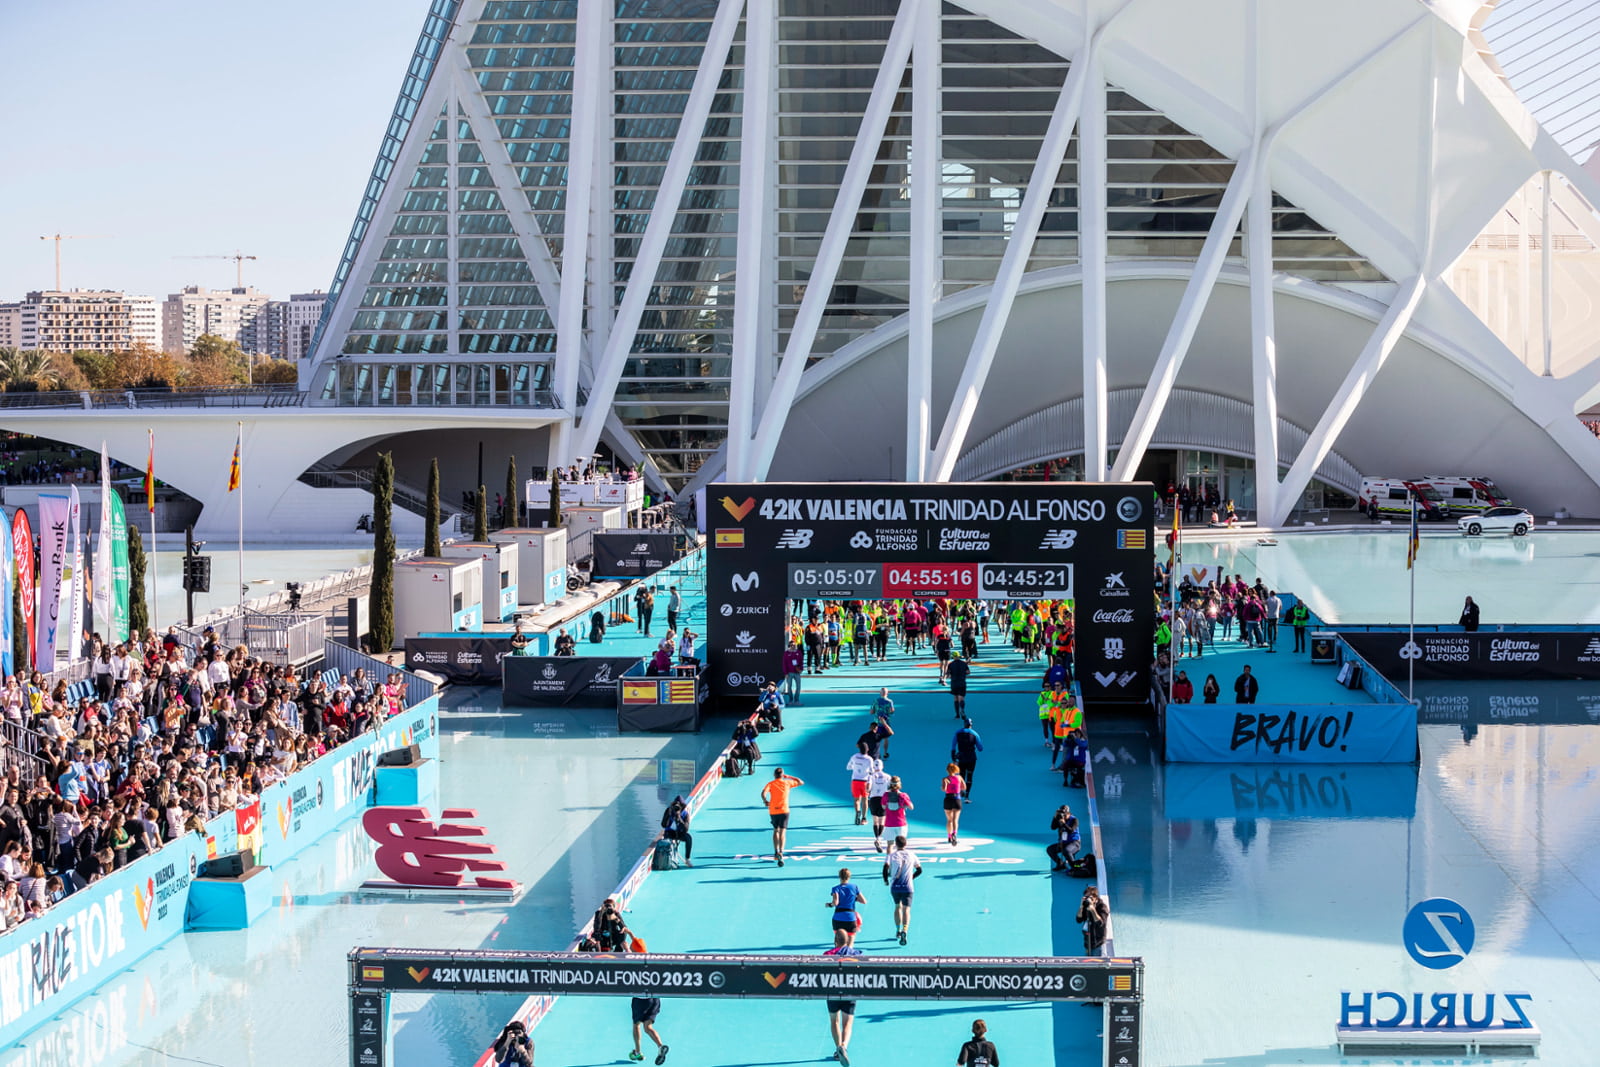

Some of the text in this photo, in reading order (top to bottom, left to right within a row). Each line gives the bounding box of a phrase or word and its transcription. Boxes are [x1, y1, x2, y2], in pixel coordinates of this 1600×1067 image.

[759, 499, 1106, 521] 42K VALENCIA TRINIDAD ALFONSO
[875, 535, 918, 543] TRINIDAD
[940, 527, 980, 539] Cultura
[875, 543, 918, 551] ALFONSO
[939, 539, 990, 551] Esfuerzo
[794, 569, 877, 585] 05:05:07
[889, 569, 972, 585] 04:55:16
[984, 569, 1065, 586] 04:45:21
[736, 606, 769, 614] ZURICH
[1425, 645, 1470, 653] TRINIDAD
[1491, 638, 1529, 650] Cultura
[1425, 653, 1470, 662] ALFONSO
[1490, 650, 1540, 662] Esfuerzo
[743, 672, 766, 686] edp
[1230, 710, 1354, 755] BRAVO!
[836, 854, 1025, 864] baance
[431, 967, 703, 987] 42K VALENCIA TRINIDAD ALFONSO 2023
[788, 973, 1064, 991] 42K VALENCIA TRINIDAD ALFONSO 2023
